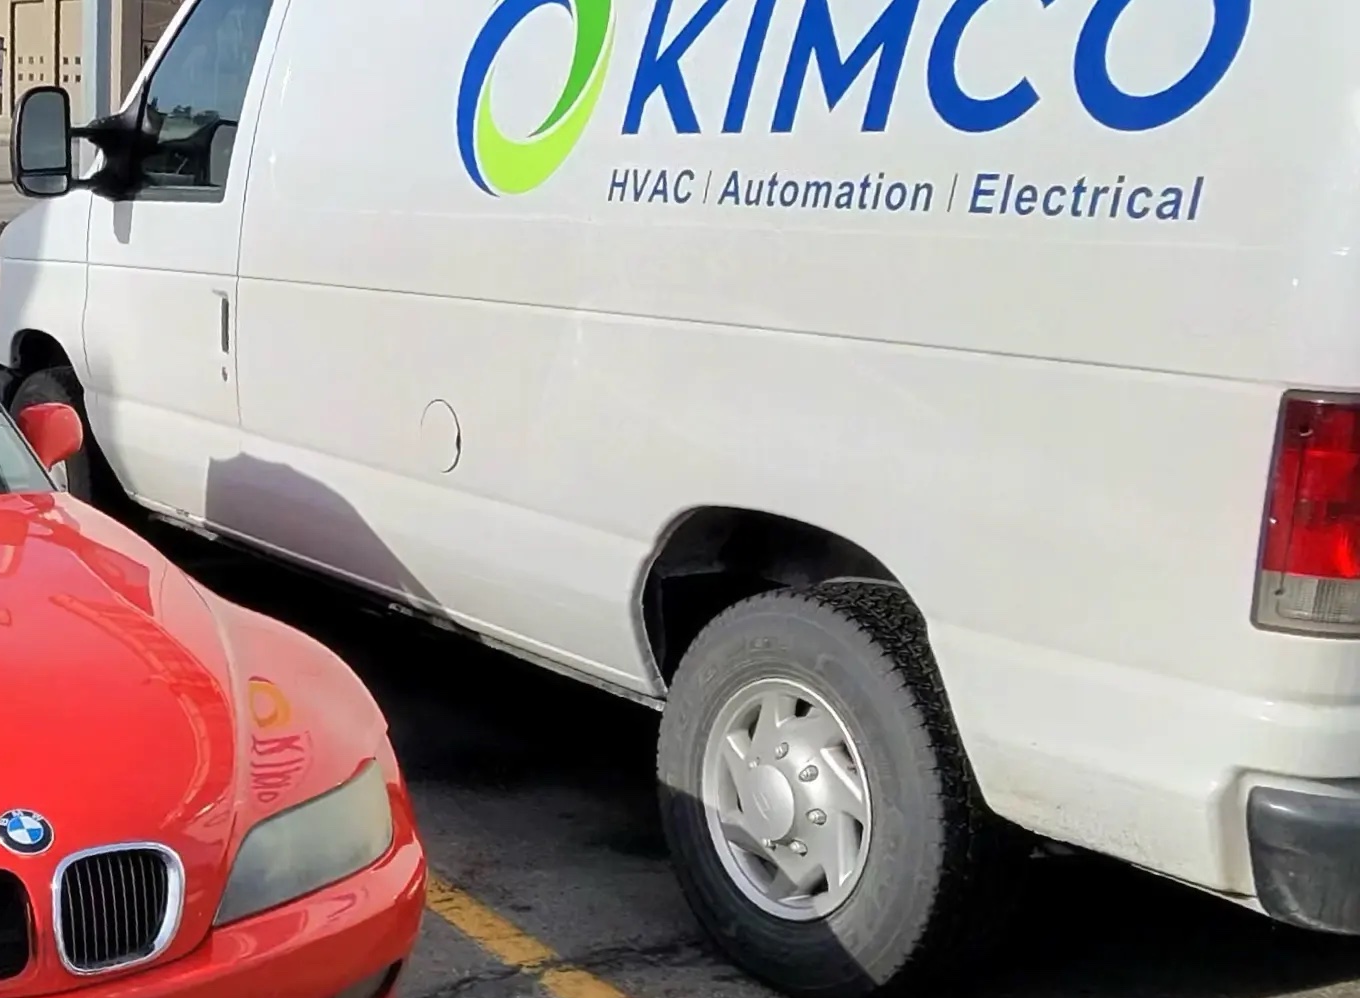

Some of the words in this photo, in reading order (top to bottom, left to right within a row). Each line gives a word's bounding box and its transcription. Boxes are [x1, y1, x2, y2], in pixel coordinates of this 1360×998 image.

[621, 0, 1252, 135] KIMCO
[608, 168, 695, 204] HVAC
[717, 170, 934, 211] Automation
[968, 173, 1205, 221] Electrical
